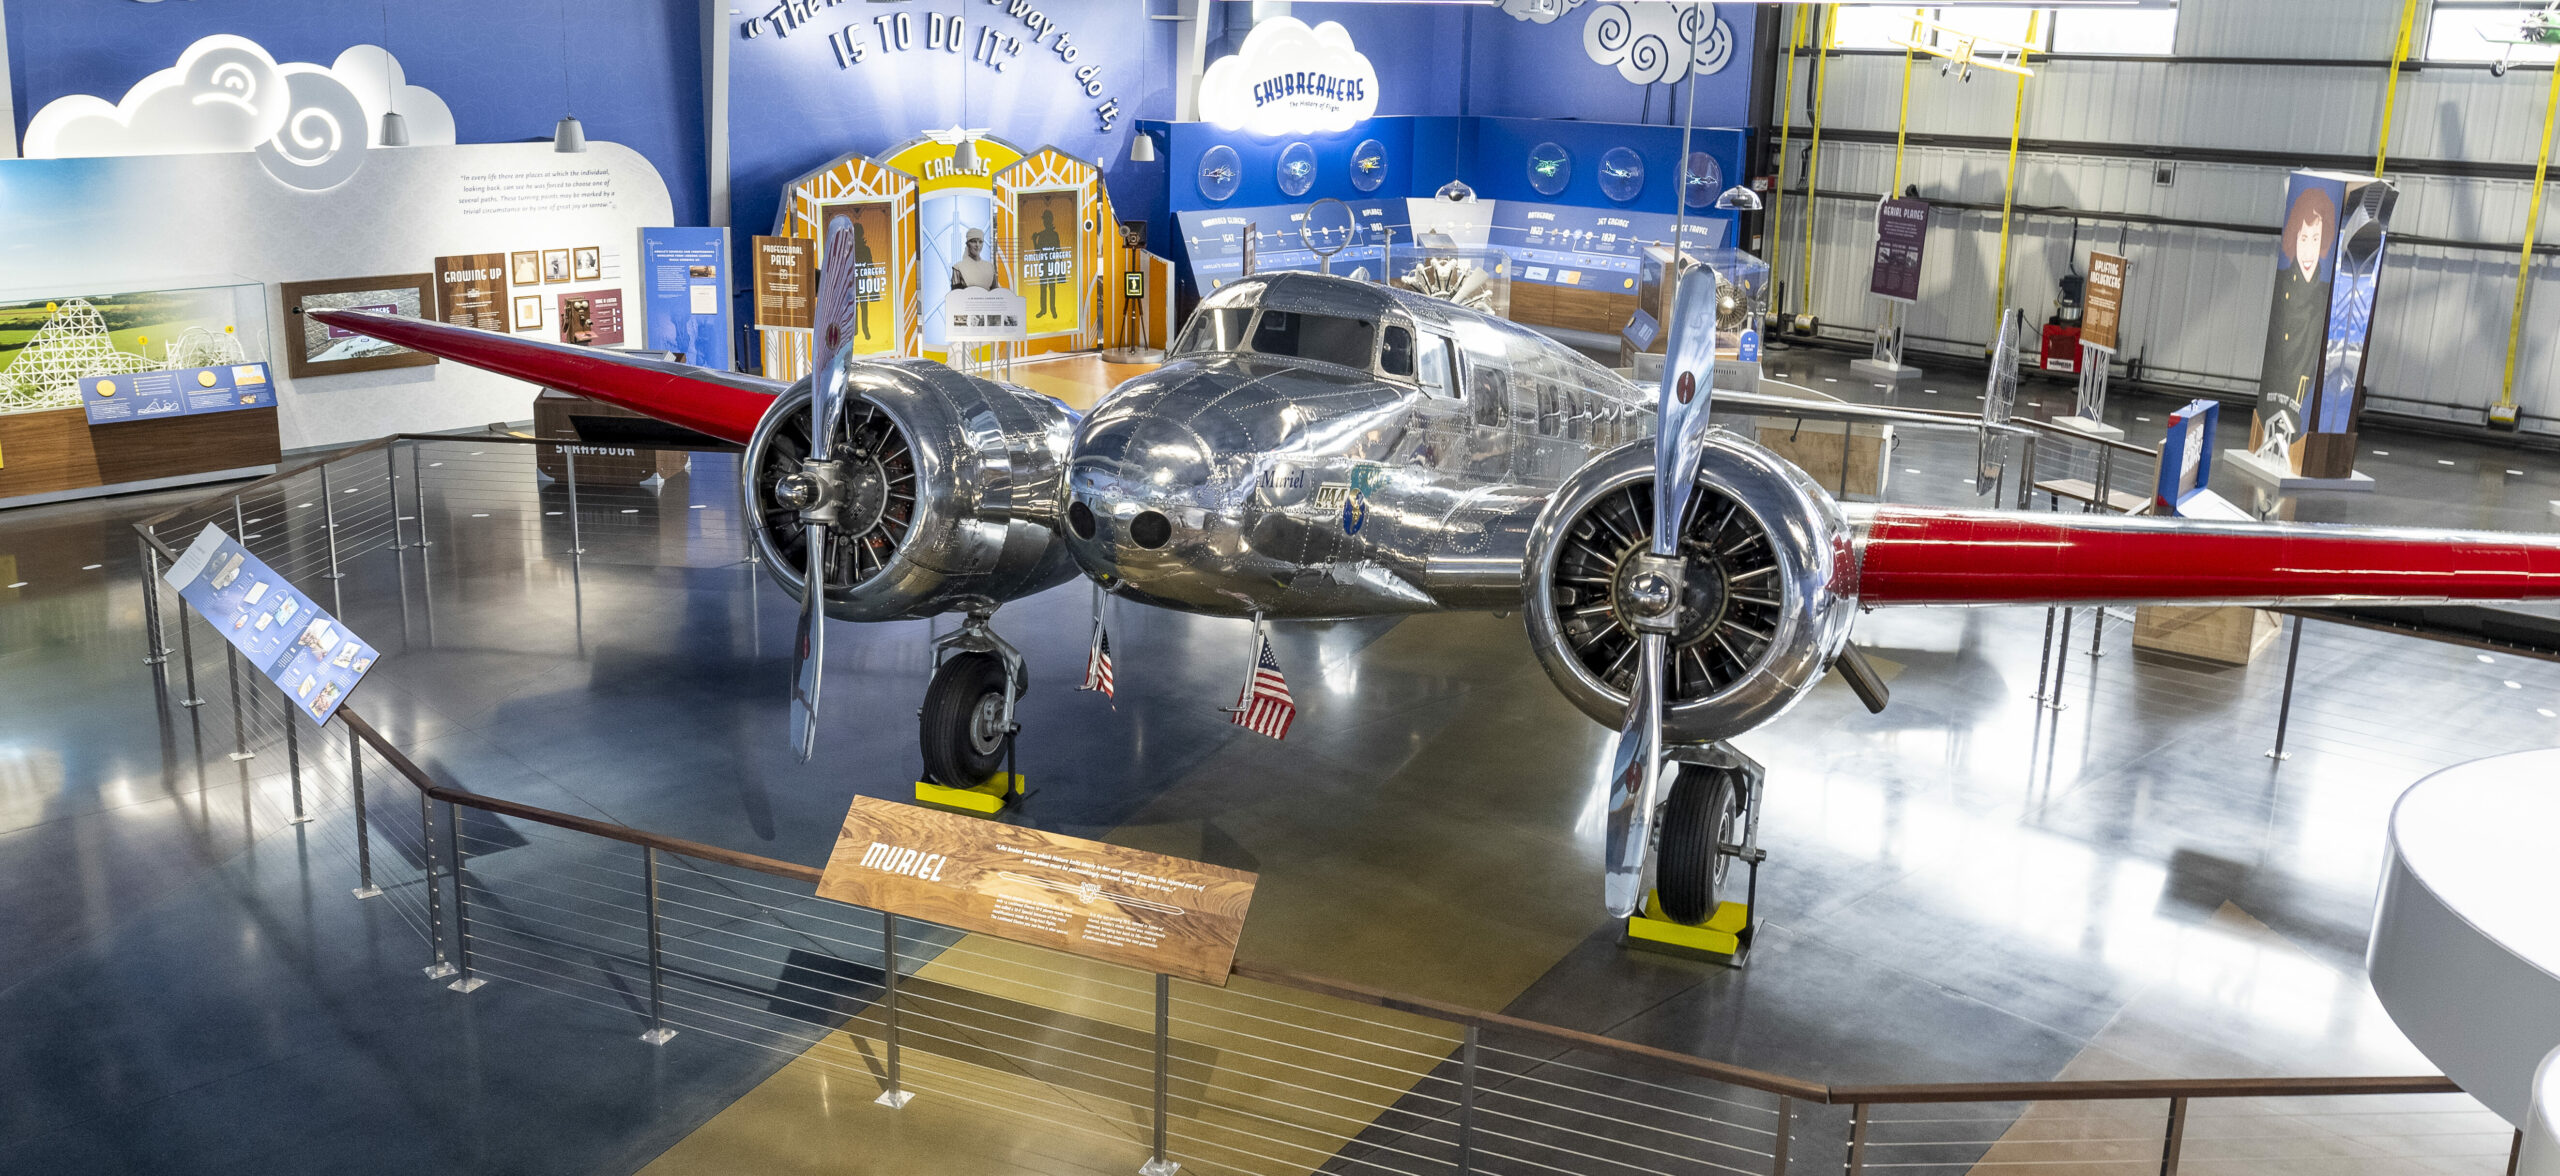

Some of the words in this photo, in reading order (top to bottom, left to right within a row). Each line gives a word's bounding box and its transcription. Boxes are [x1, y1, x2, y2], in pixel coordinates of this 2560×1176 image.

[829, 23, 868, 69] IS
[873, 12, 912, 53] TO
[926, 12, 965, 52] DO
[1005, 0, 1056, 43] way
[1052, 32, 1079, 63] to
[1075, 65, 1103, 99] do
[1253, 72, 1364, 108] SKYBREAKERS
[1883, 206, 1902, 217] AERIAL
[1903, 208, 1925, 220] PLANES
[762, 244, 803, 255] PROFESSIONAL
[770, 254, 796, 267] PATHS
[1024, 262, 1044, 278] FITS
[1047, 260, 1072, 276] YOU?
[2094, 260, 2119, 275] UPLIFTING
[444, 268, 487, 283] GROWING
[490, 268, 502, 280] UP
[2089, 271, 2121, 289] INFLUENCERS
[858, 277, 886, 294] YOU?
[1260, 469, 1305, 489] Muriel
[860, 841, 947, 882] MURIEL
